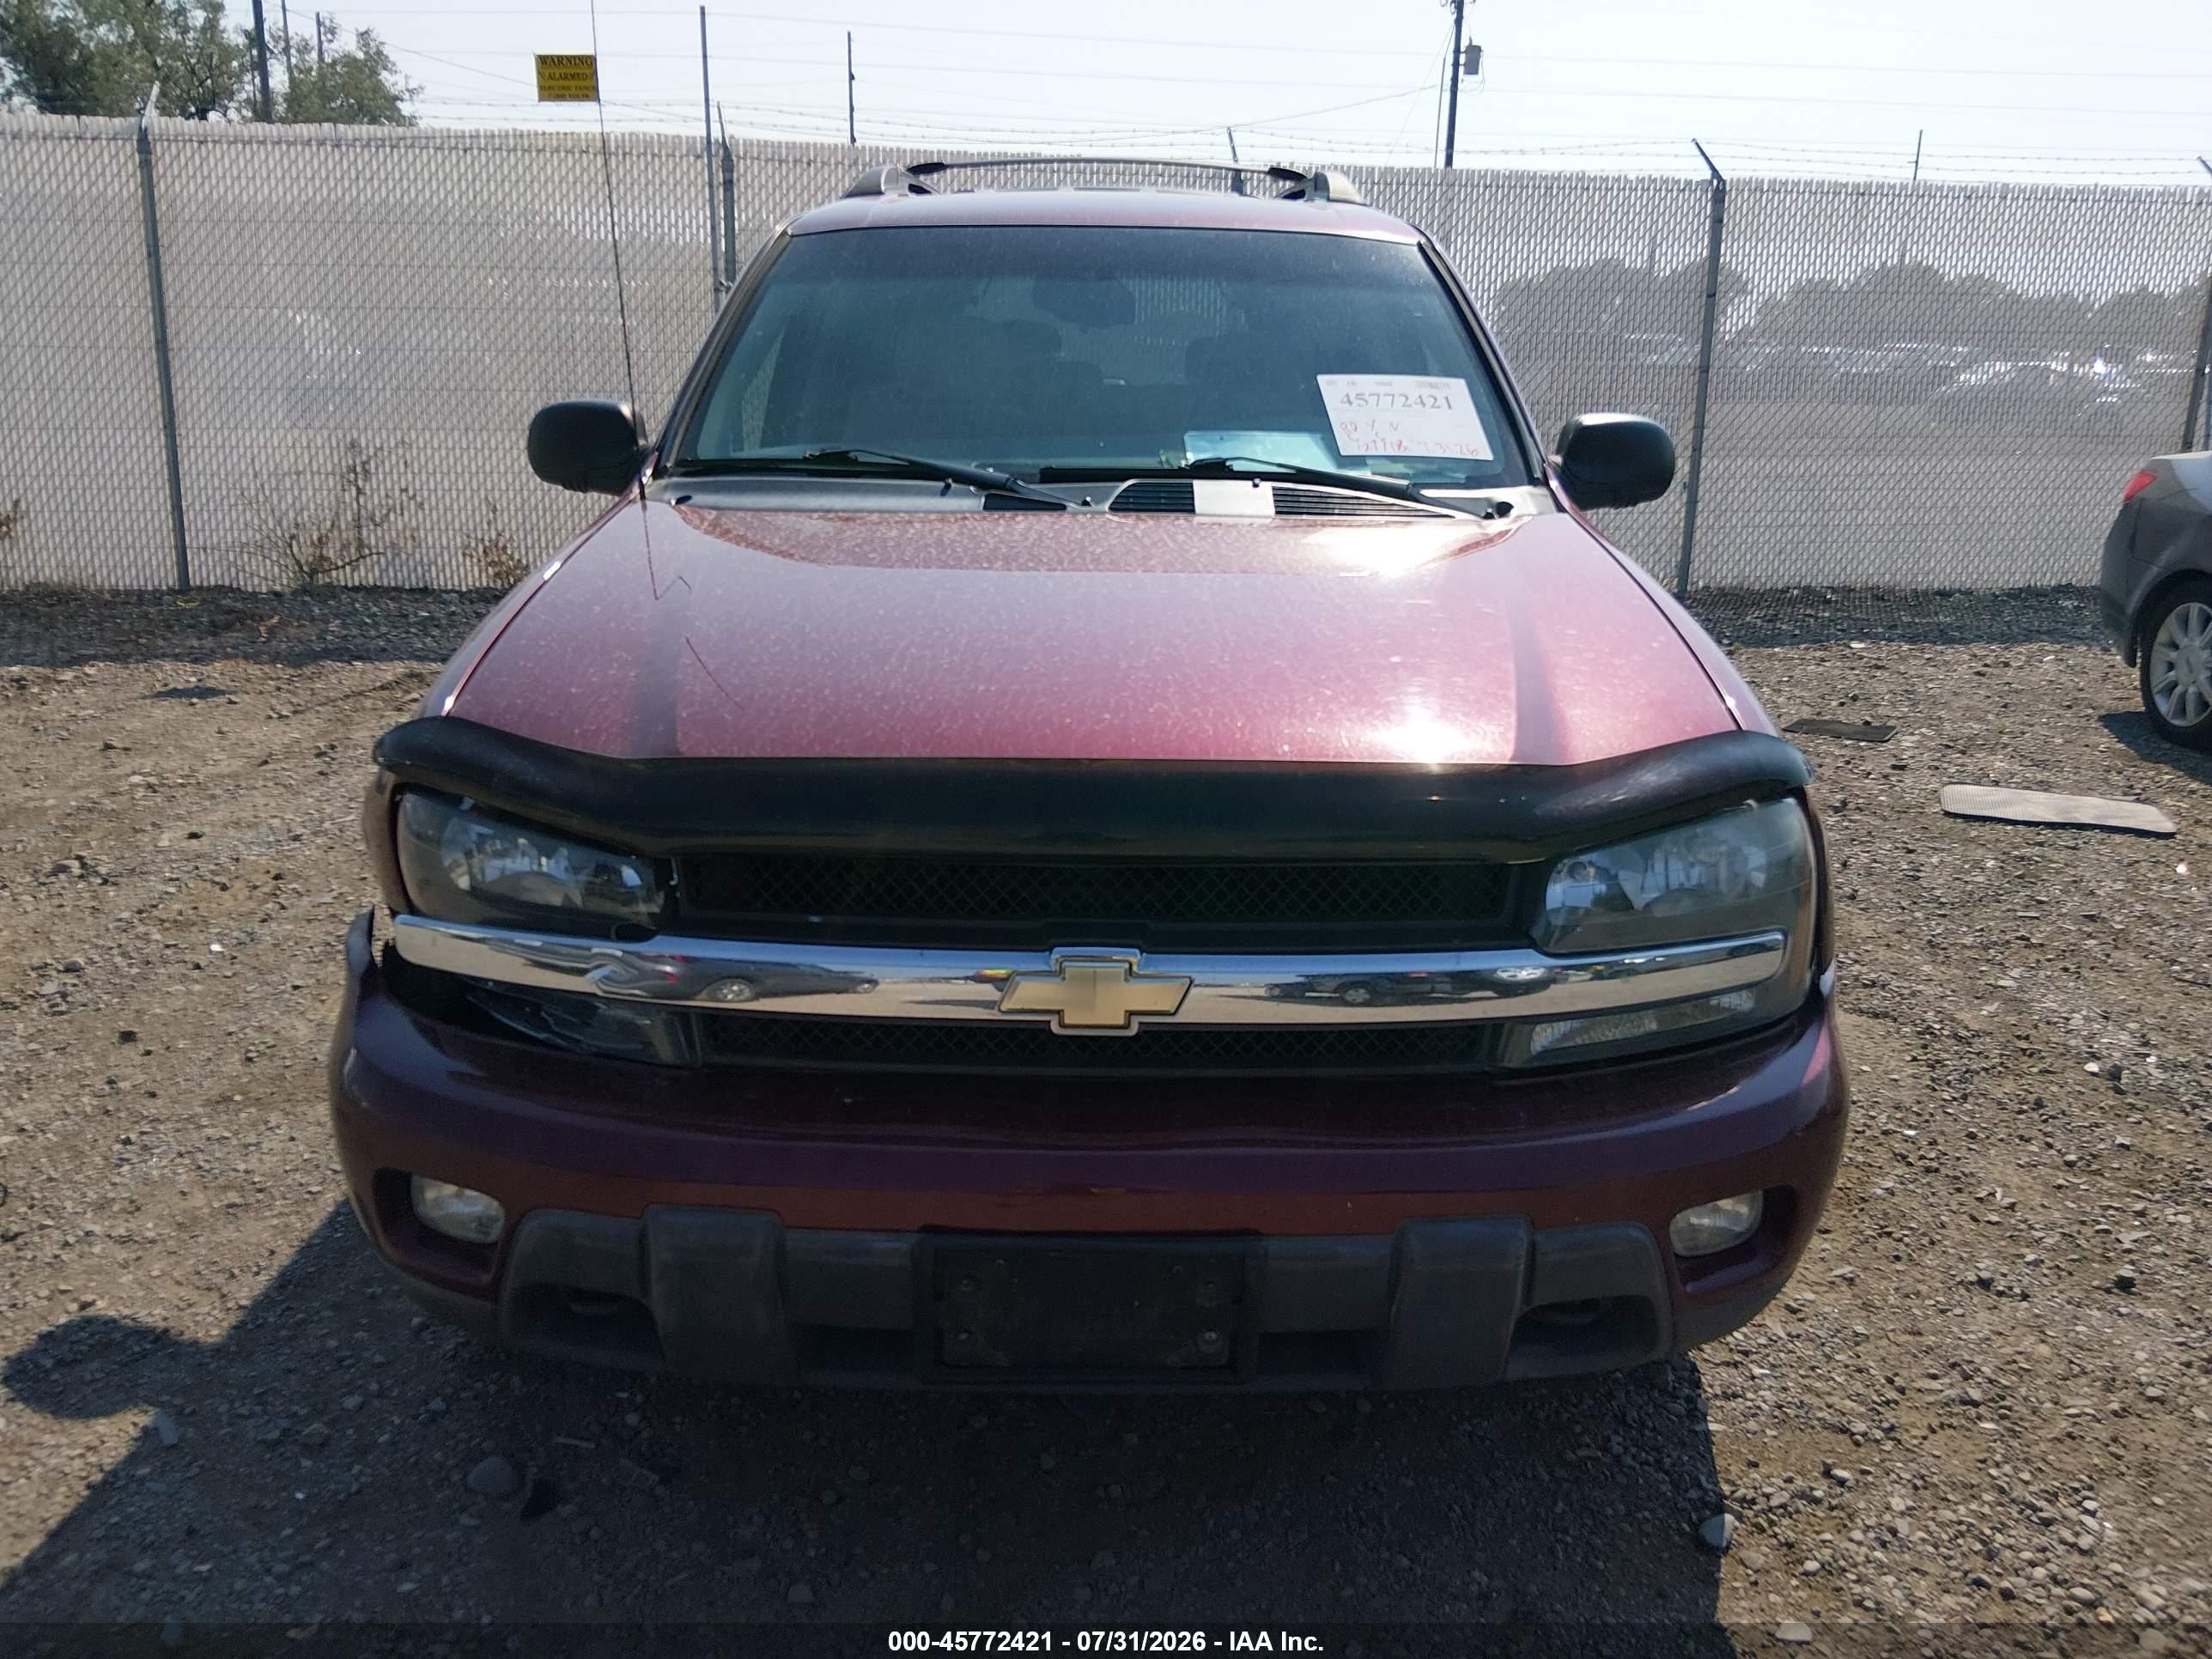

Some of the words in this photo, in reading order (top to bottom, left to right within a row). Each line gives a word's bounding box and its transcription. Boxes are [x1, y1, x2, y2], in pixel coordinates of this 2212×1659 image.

[539, 56, 593, 67] WARNING
[548, 71, 588, 81] ALARMED
[1340, 392, 1453, 410] 45772421
